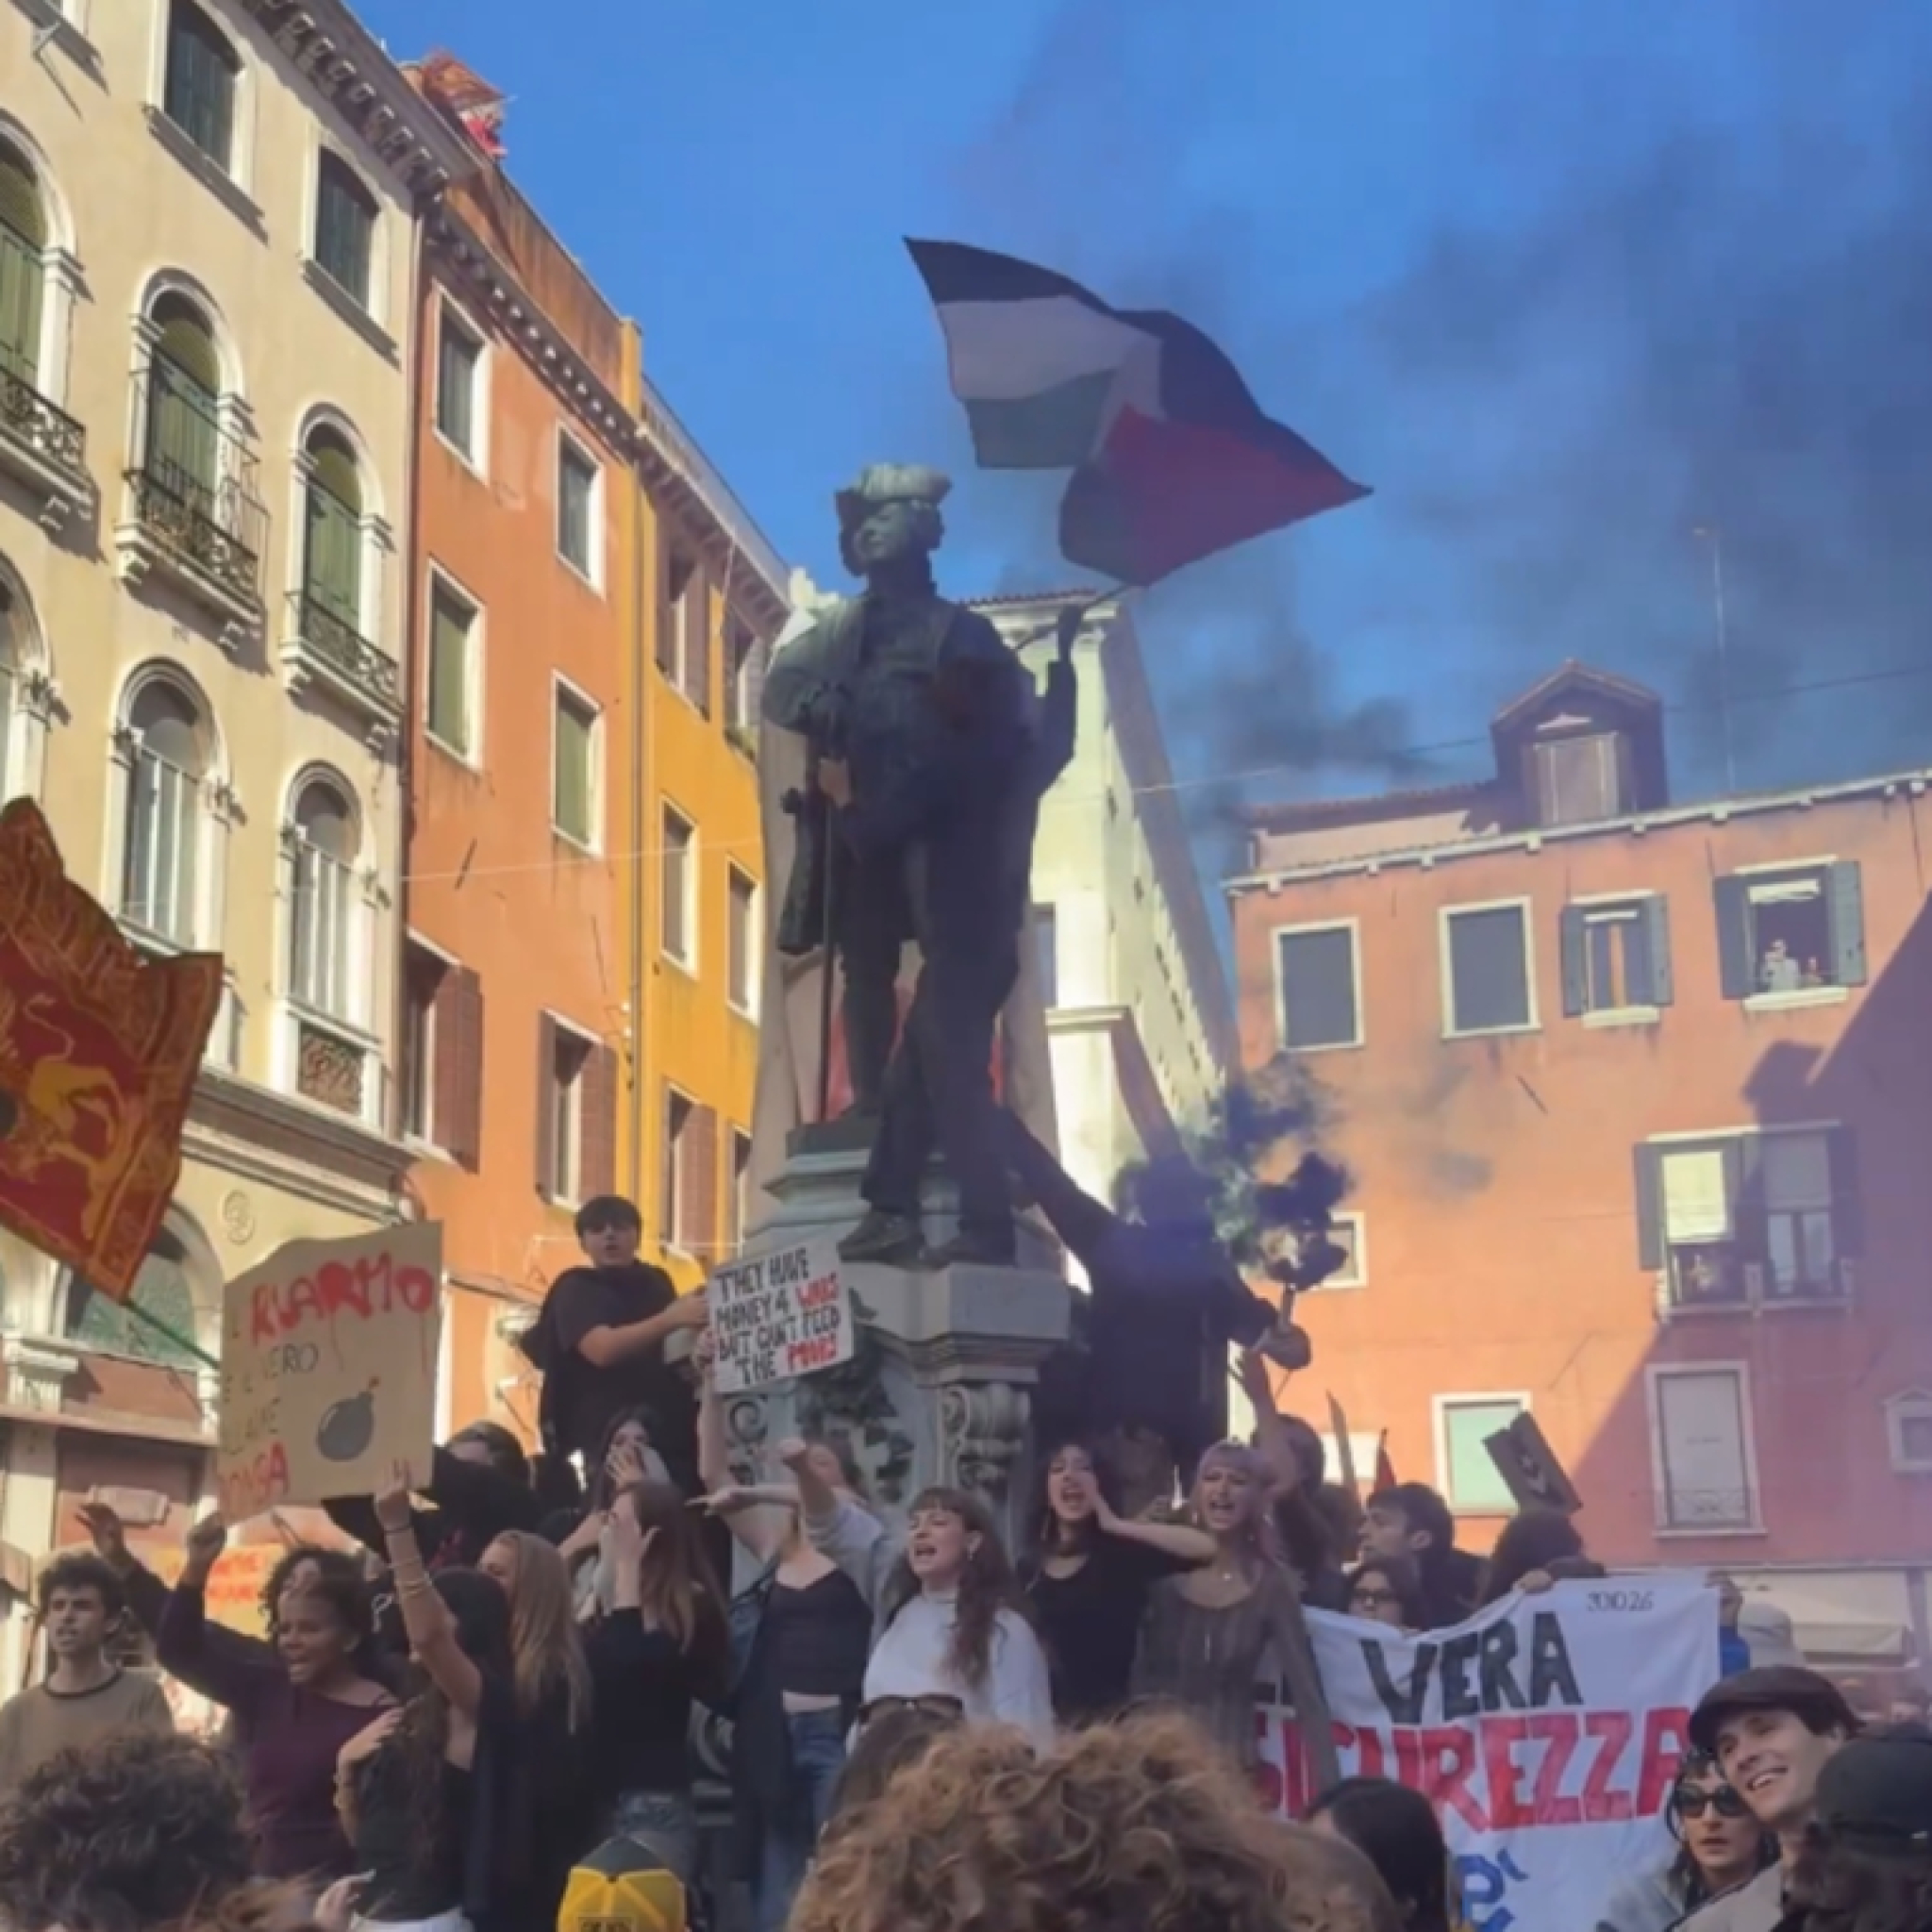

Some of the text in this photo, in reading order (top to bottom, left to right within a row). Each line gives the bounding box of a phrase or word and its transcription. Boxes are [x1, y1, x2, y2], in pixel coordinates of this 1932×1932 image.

[714, 1247, 809, 1304] THEY HAVE
[715, 1291, 772, 1332] MONEY
[774, 1288, 790, 1314] 4
[734, 1350, 776, 1386] THE
[1358, 1610, 1584, 1725] VERA
